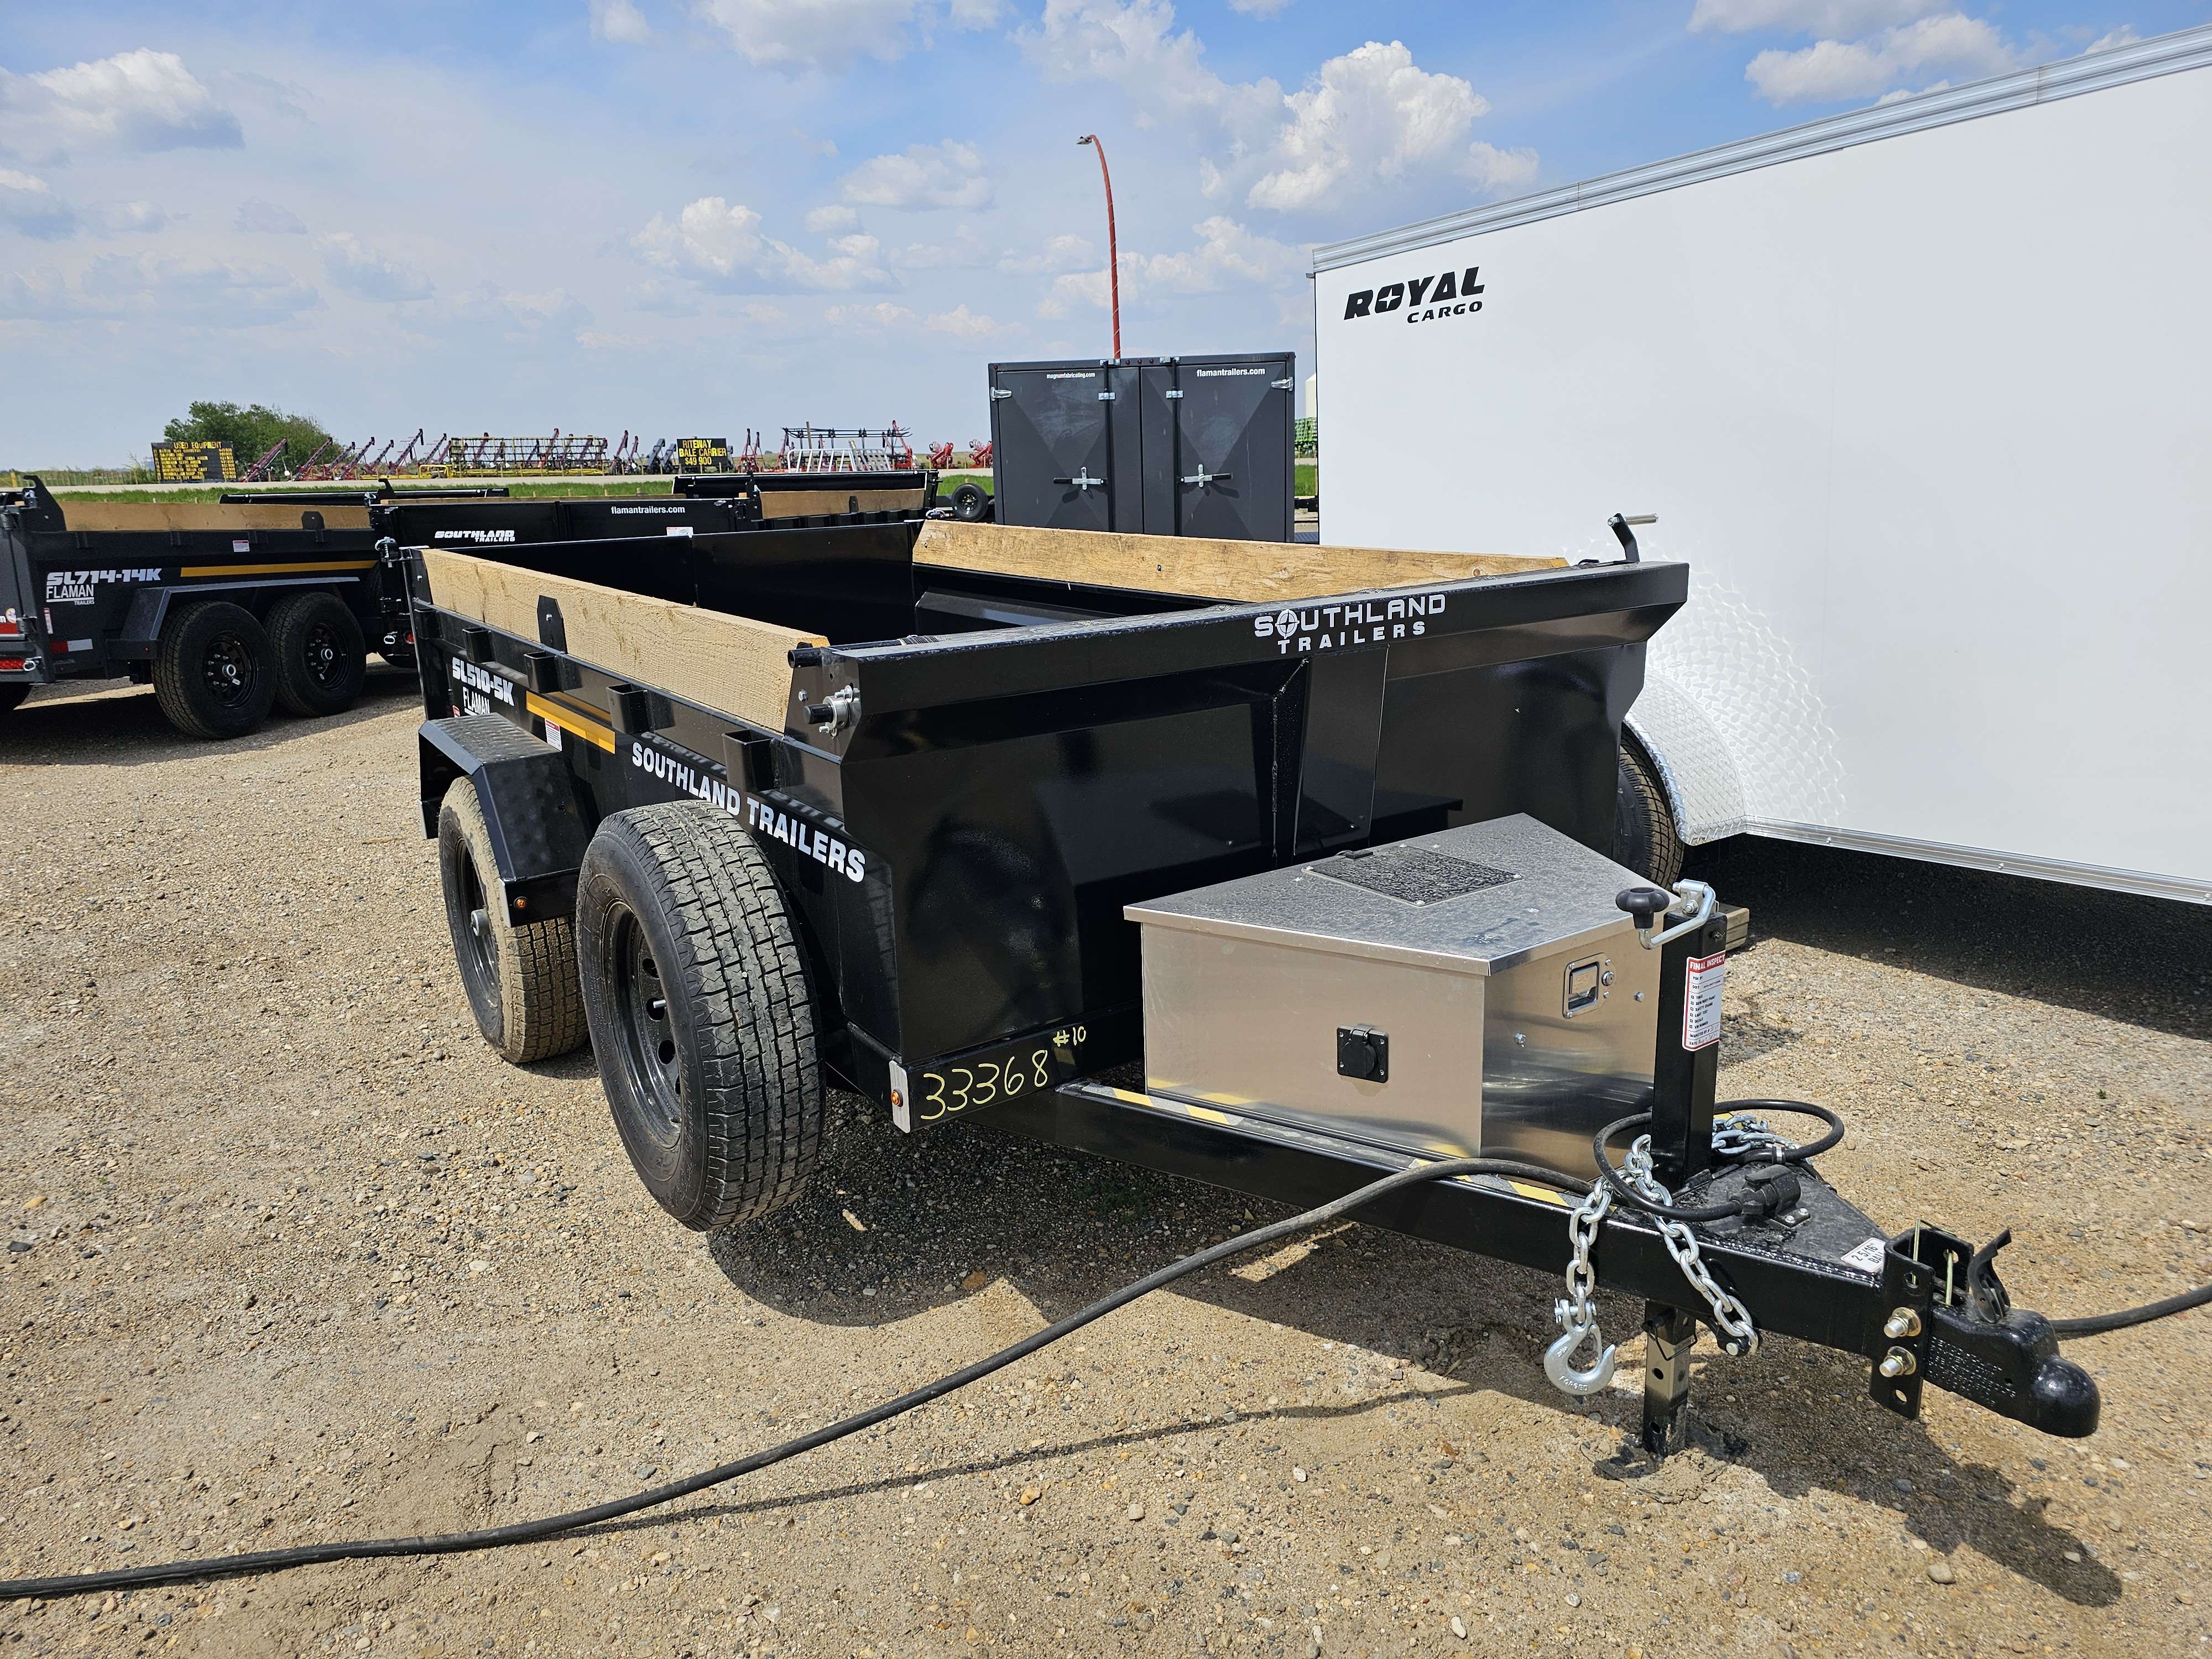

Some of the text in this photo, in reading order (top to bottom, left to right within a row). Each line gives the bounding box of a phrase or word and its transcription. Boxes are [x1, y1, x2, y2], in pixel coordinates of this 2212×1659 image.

[1344, 267, 1485, 320] ROYAL
[1407, 301, 1483, 324] CARGO
[1196, 367, 1265, 377] flamantrailers.com
[679, 448, 727, 457] BALE CARRIER
[682, 440, 712, 448] RITEWAY
[685, 457, 712, 465] $49 900
[611, 506, 685, 514] flamantrailers.com
[46, 568, 162, 586] SL714-14K
[46, 585, 93, 599] FLAMAN
[1254, 594, 1445, 638] SOUTHLAND
[1277, 621, 1426, 654] TRAILERS
[452, 656, 515, 706] SL510-5K
[462, 686, 491, 715] FLAMAN
[632, 742, 866, 883] SOUTHLAND TRAILERS
[1689, 962, 1705, 971] FINAL
[1053, 1026, 1086, 1047] #10
[920, 1050, 1048, 1120] 33368
